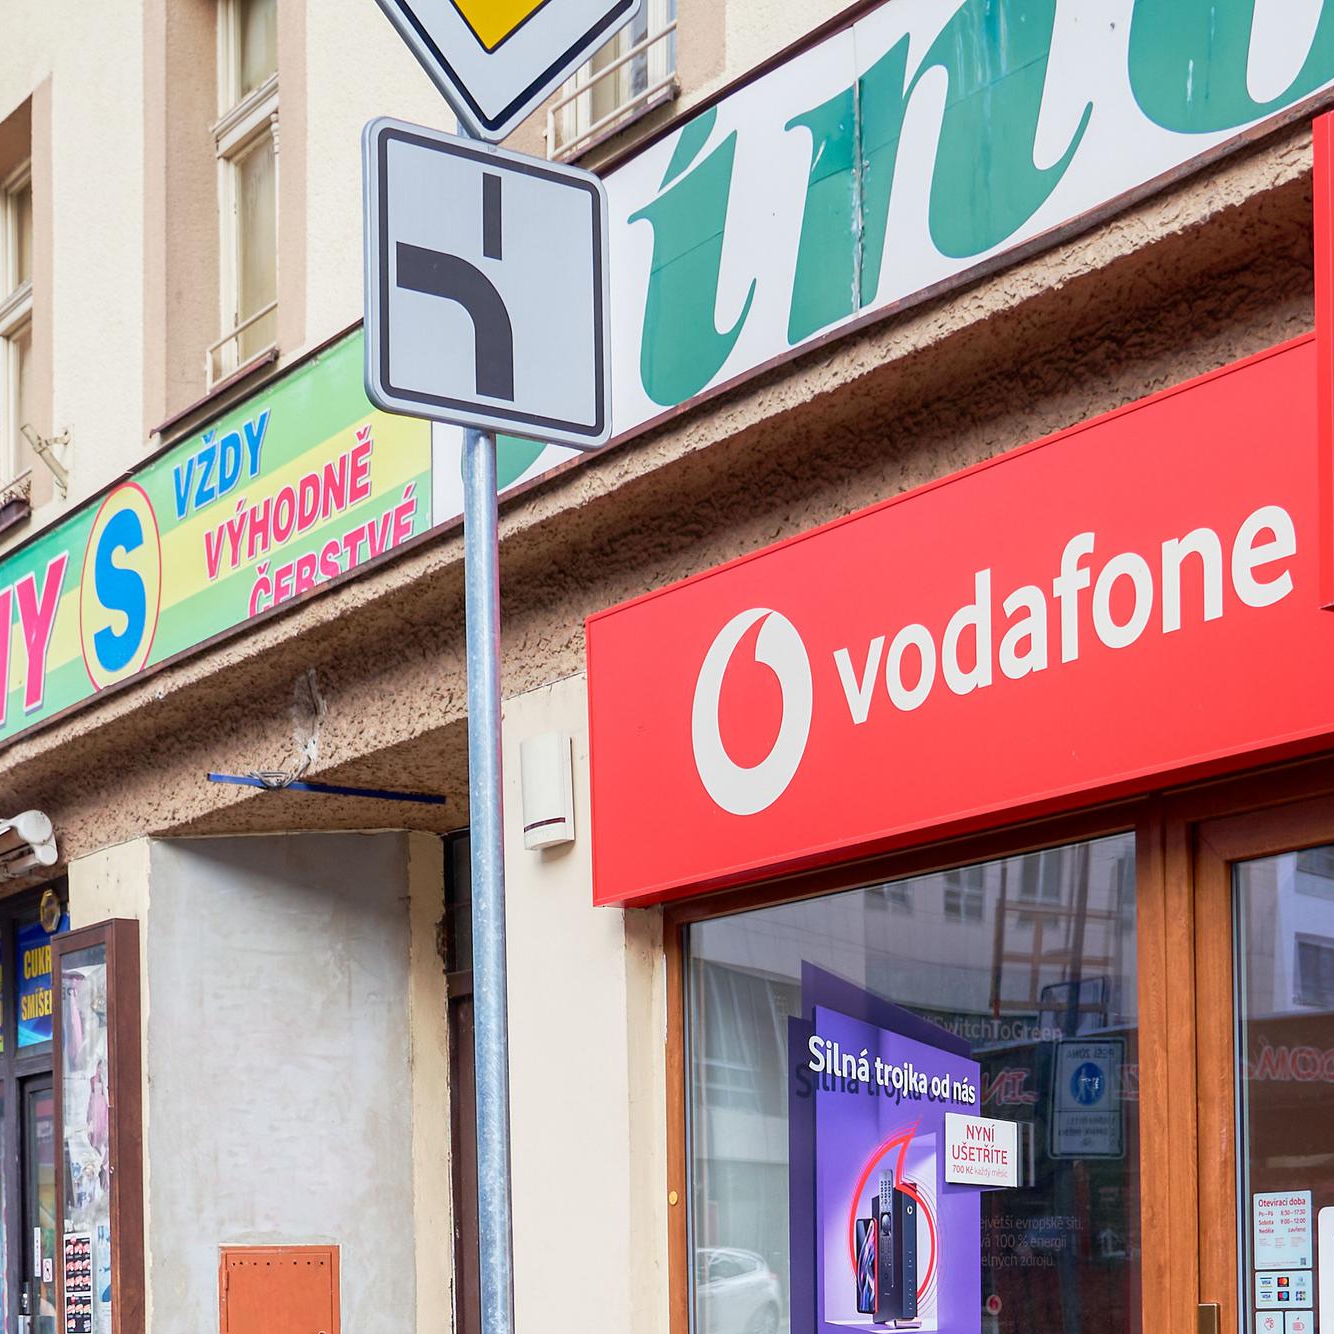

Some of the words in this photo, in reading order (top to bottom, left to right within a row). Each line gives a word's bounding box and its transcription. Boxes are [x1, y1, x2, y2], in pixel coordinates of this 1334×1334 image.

[172, 407, 271, 521] VŽDY
[204, 424, 373, 582] VÝHODNĚ
[249, 481, 418, 617] ČERSTVÉ
[93, 507, 147, 673] S
[832, 504, 1298, 725] vodafone
[23, 944, 52, 980] CUKR
[21, 988, 52, 1021] SMÍŠE
[808, 1035, 870, 1083] Silná
[874, 1055, 928, 1097] trojka
[931, 1072, 950, 1099] od
[953, 1076, 976, 1105] nás
[965, 1123, 995, 1143] NYNÍ
[951, 1143, 1008, 1166] UŠETŘÍTE
[952, 1164, 965, 1175] 700
[965, 1165, 973, 1175] Kč
[1289, 1197, 1306, 1206] doba
[980, 1215, 1012, 1231] ejvětší
[995, 1234, 1016, 1249] 100
[981, 1253, 1017, 1270] elných
